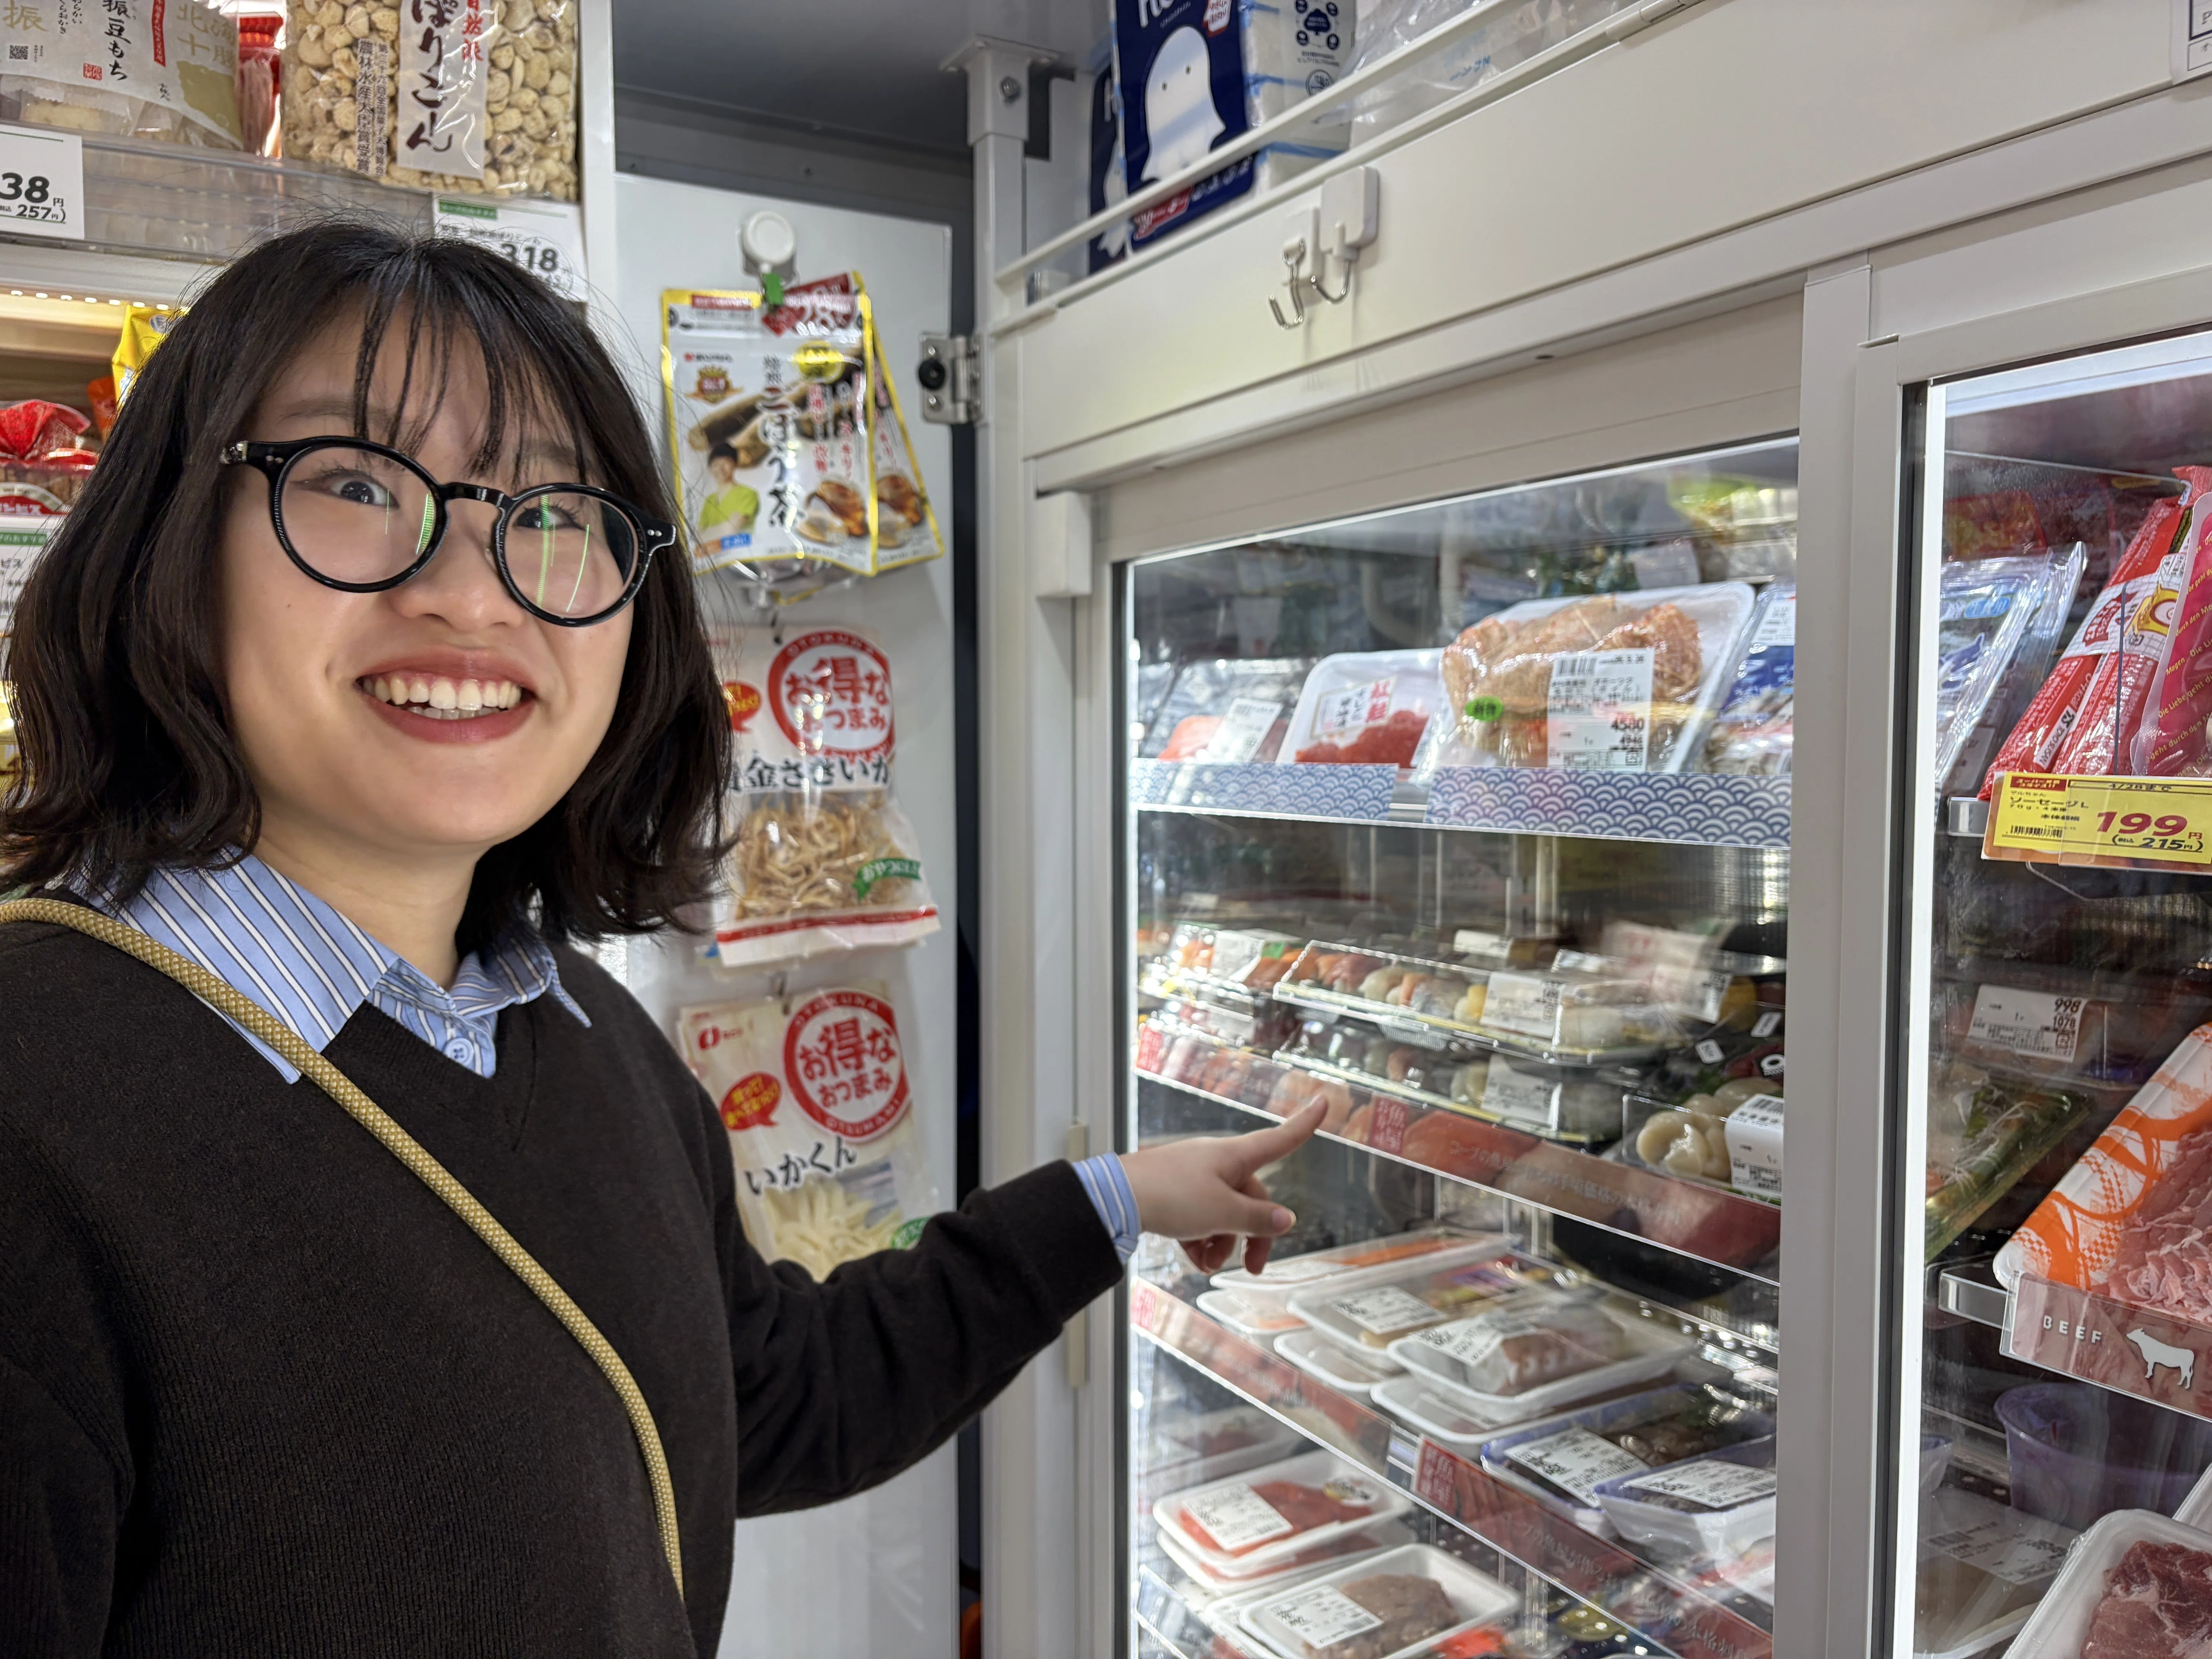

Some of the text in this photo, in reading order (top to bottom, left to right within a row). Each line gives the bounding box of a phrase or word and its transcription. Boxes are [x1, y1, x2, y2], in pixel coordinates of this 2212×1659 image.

[2166, 657, 2185, 675] Magen
[2190, 645, 2203, 657] Die
[2158, 707, 2169, 719] Die
[2169, 694, 2186, 710] Liebe
[2188, 681, 2205, 697] geht
[2150, 744, 2167, 761] geht
[2169, 730, 2188, 747] durch
[734, 752, 889, 792] 金さきいか
[2054, 997, 2081, 1013] 998
[799, 1017, 896, 1082] お得な
[818, 1067, 892, 1108] おつまみ
[745, 1137, 857, 1194] いかくん
[2043, 1315, 2103, 1344] BEEF
